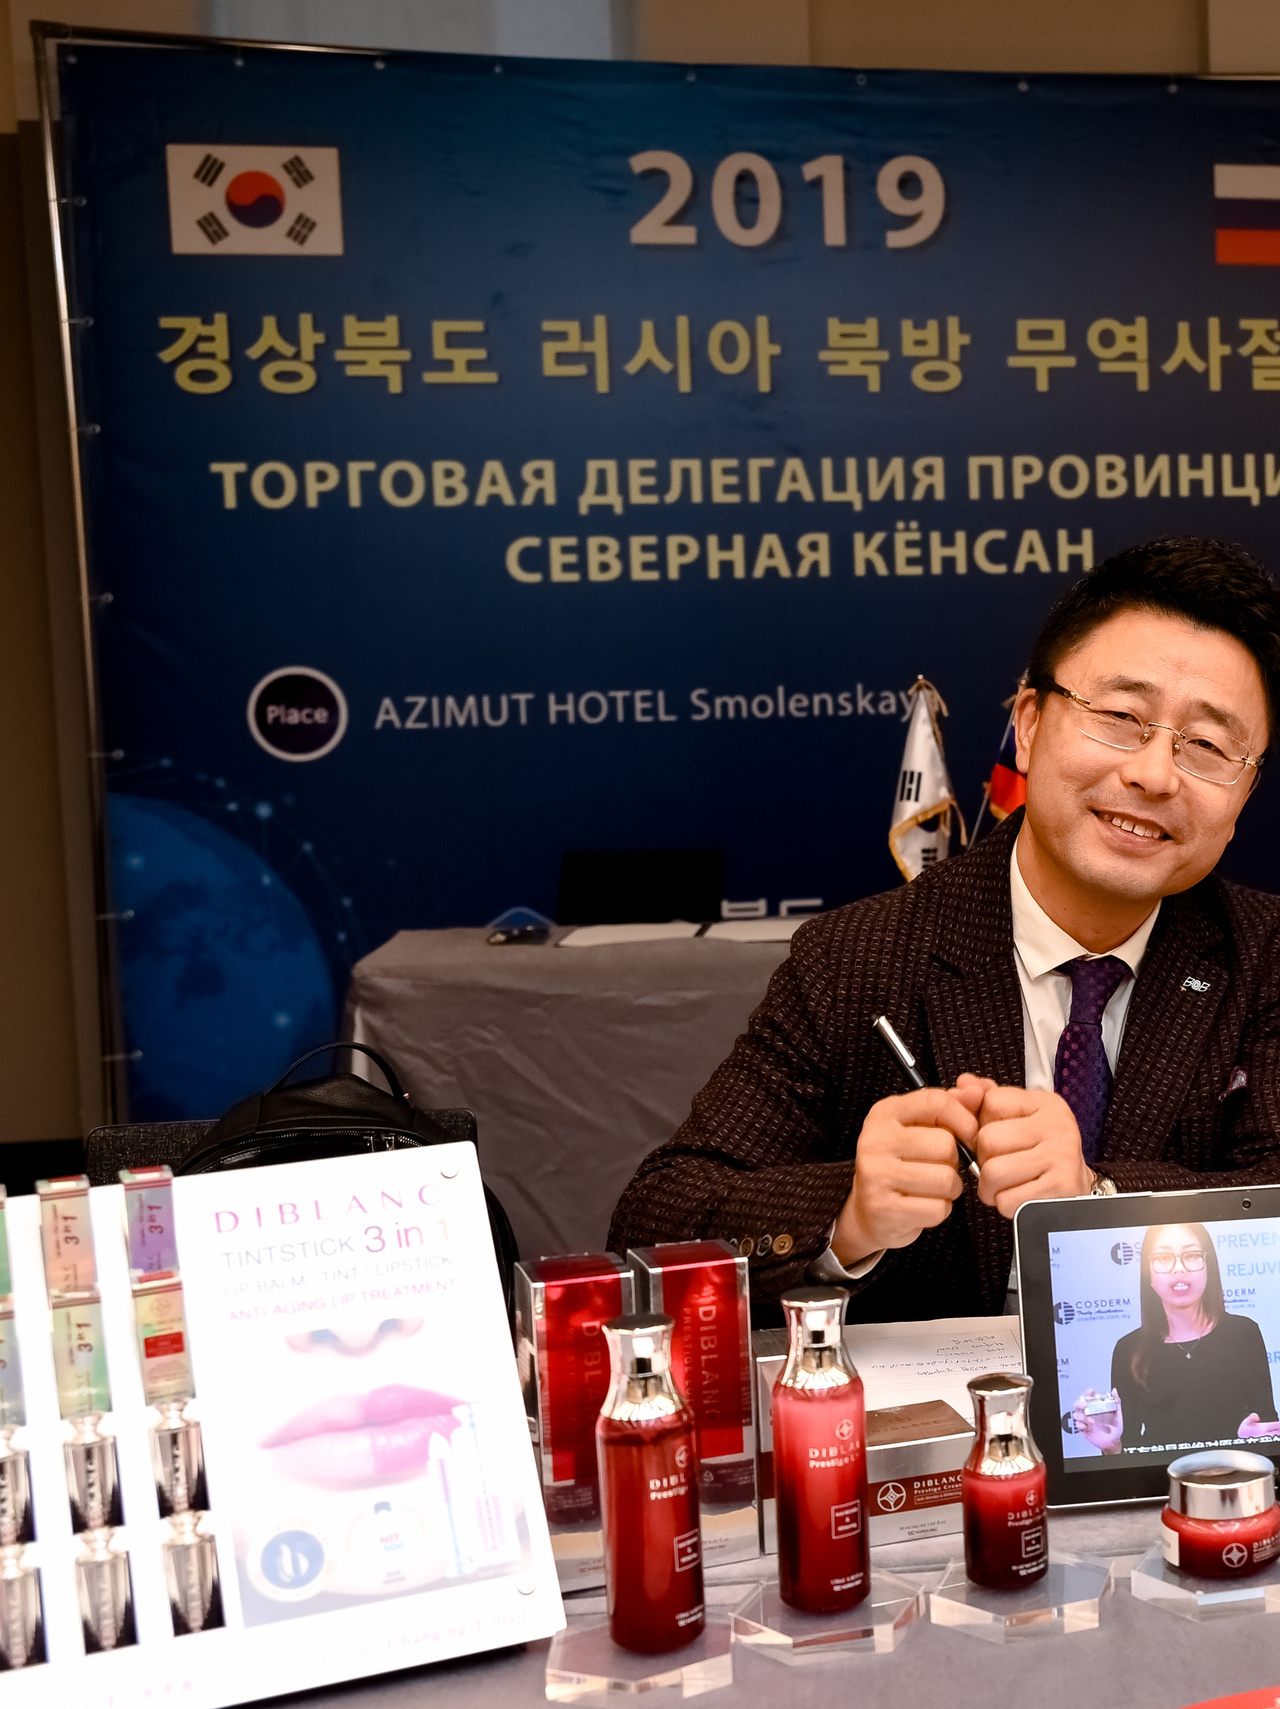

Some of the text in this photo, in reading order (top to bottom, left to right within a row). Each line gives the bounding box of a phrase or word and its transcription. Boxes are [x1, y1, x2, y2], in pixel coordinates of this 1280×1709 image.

[629, 150, 946, 249] 2019
[158, 312, 499, 394] 경상북도
[541, 314, 782, 394] 러시아
[818, 315, 971, 393] 북방
[209, 459, 557, 510] ТОРГОВАЯ
[577, 456, 946, 516] ДЕЛЕГАЦИЯ
[505, 521, 1096, 584] СЕВЕРНАЯ КЁНСАН
[266, 703, 330, 727] Place
[374, 694, 536, 730] AZIMUT
[547, 690, 679, 726] HOTEL
[214, 1183, 442, 1234] DIBLANC
[221, 1215, 449, 1270] TINTSTICK 3 in 1
[223, 1253, 453, 1298] LIP BALM TINT LIPSTICK
[331, 1277, 456, 1307] LIP TREATMENT
[1075, 1298, 1131, 1309] COSDERM
[698, 1304, 721, 1426] DIBLANC
[913, 1474, 962, 1489] DIBLANC
[913, 1484, 942, 1495] Prestige
